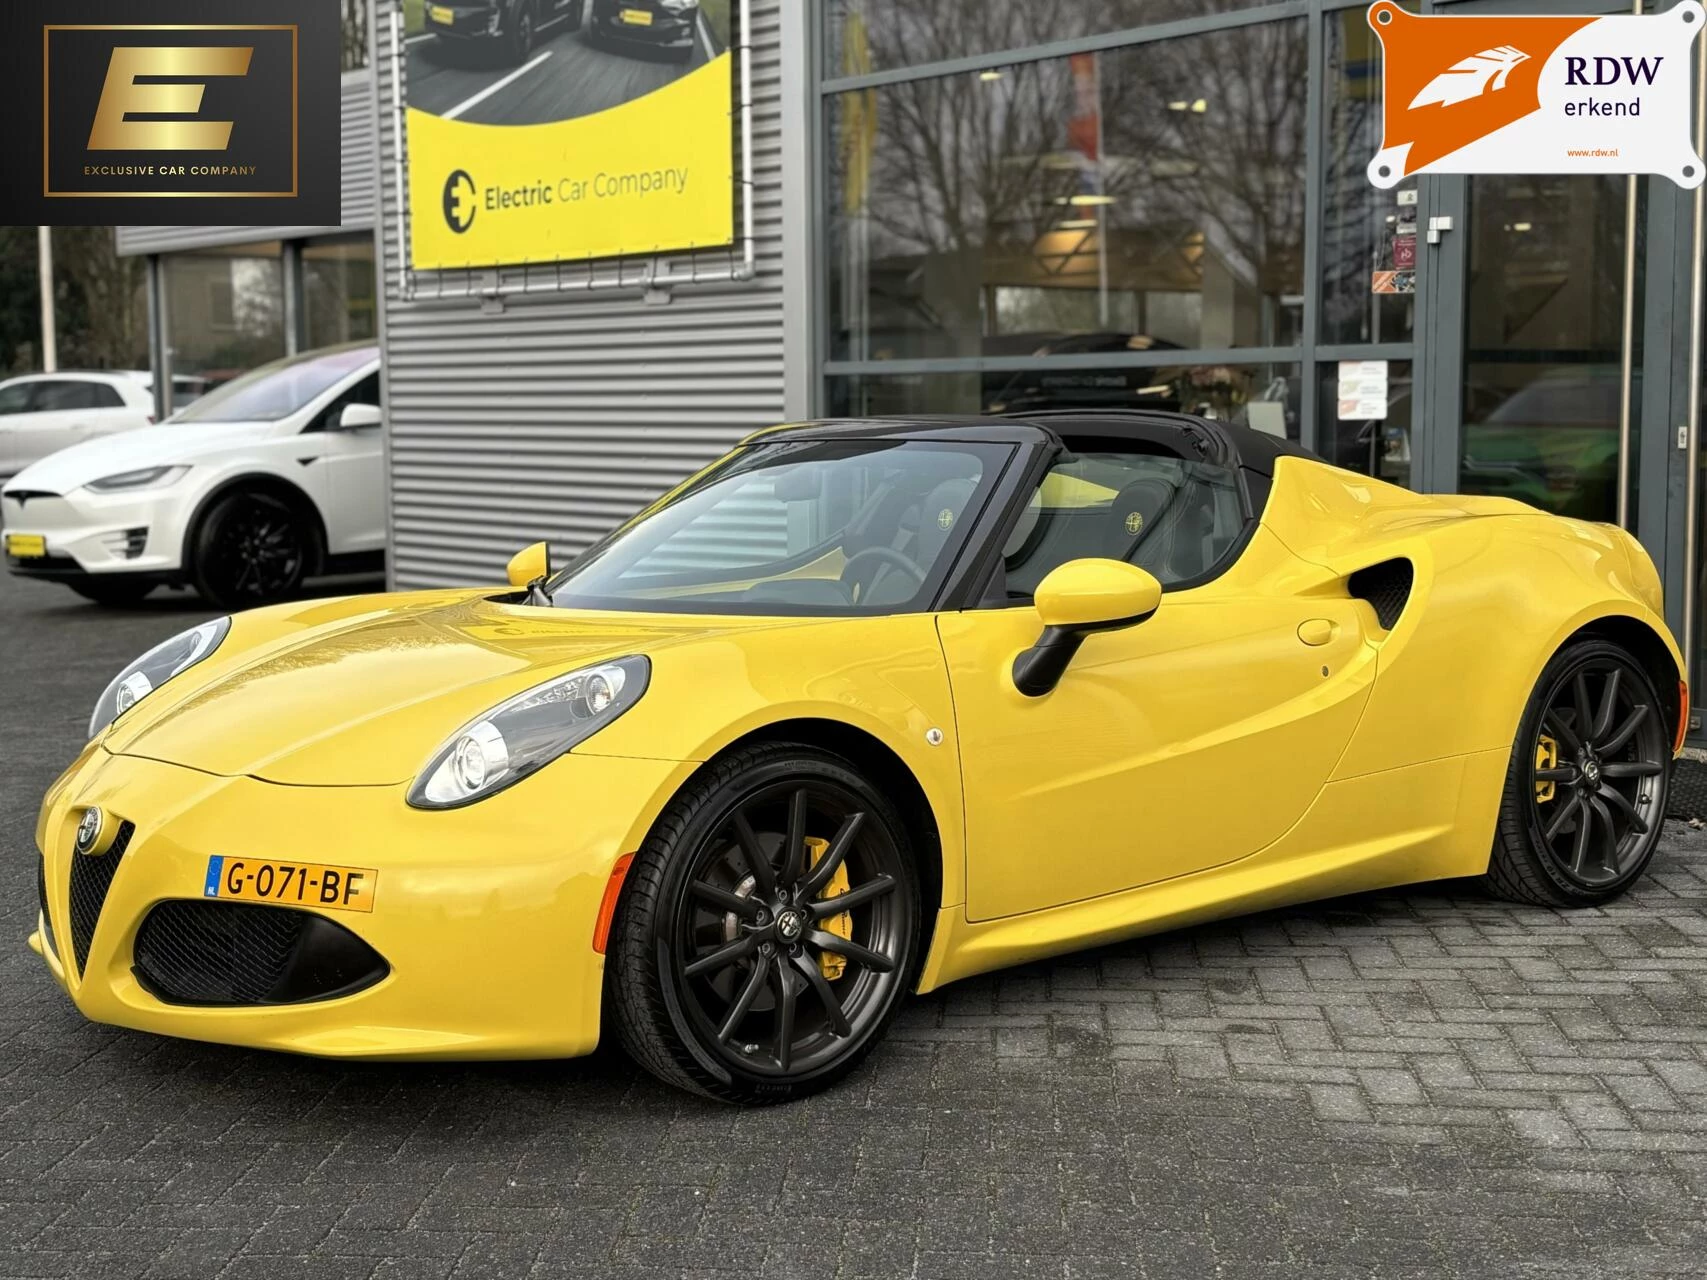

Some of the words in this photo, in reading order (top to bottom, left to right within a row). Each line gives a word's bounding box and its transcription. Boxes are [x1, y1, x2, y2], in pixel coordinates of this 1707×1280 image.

[485, 179, 553, 211] Electric
[558, 177, 588, 202] Car
[594, 167, 688, 198] Company
[227, 862, 364, 905] G-071-BF
